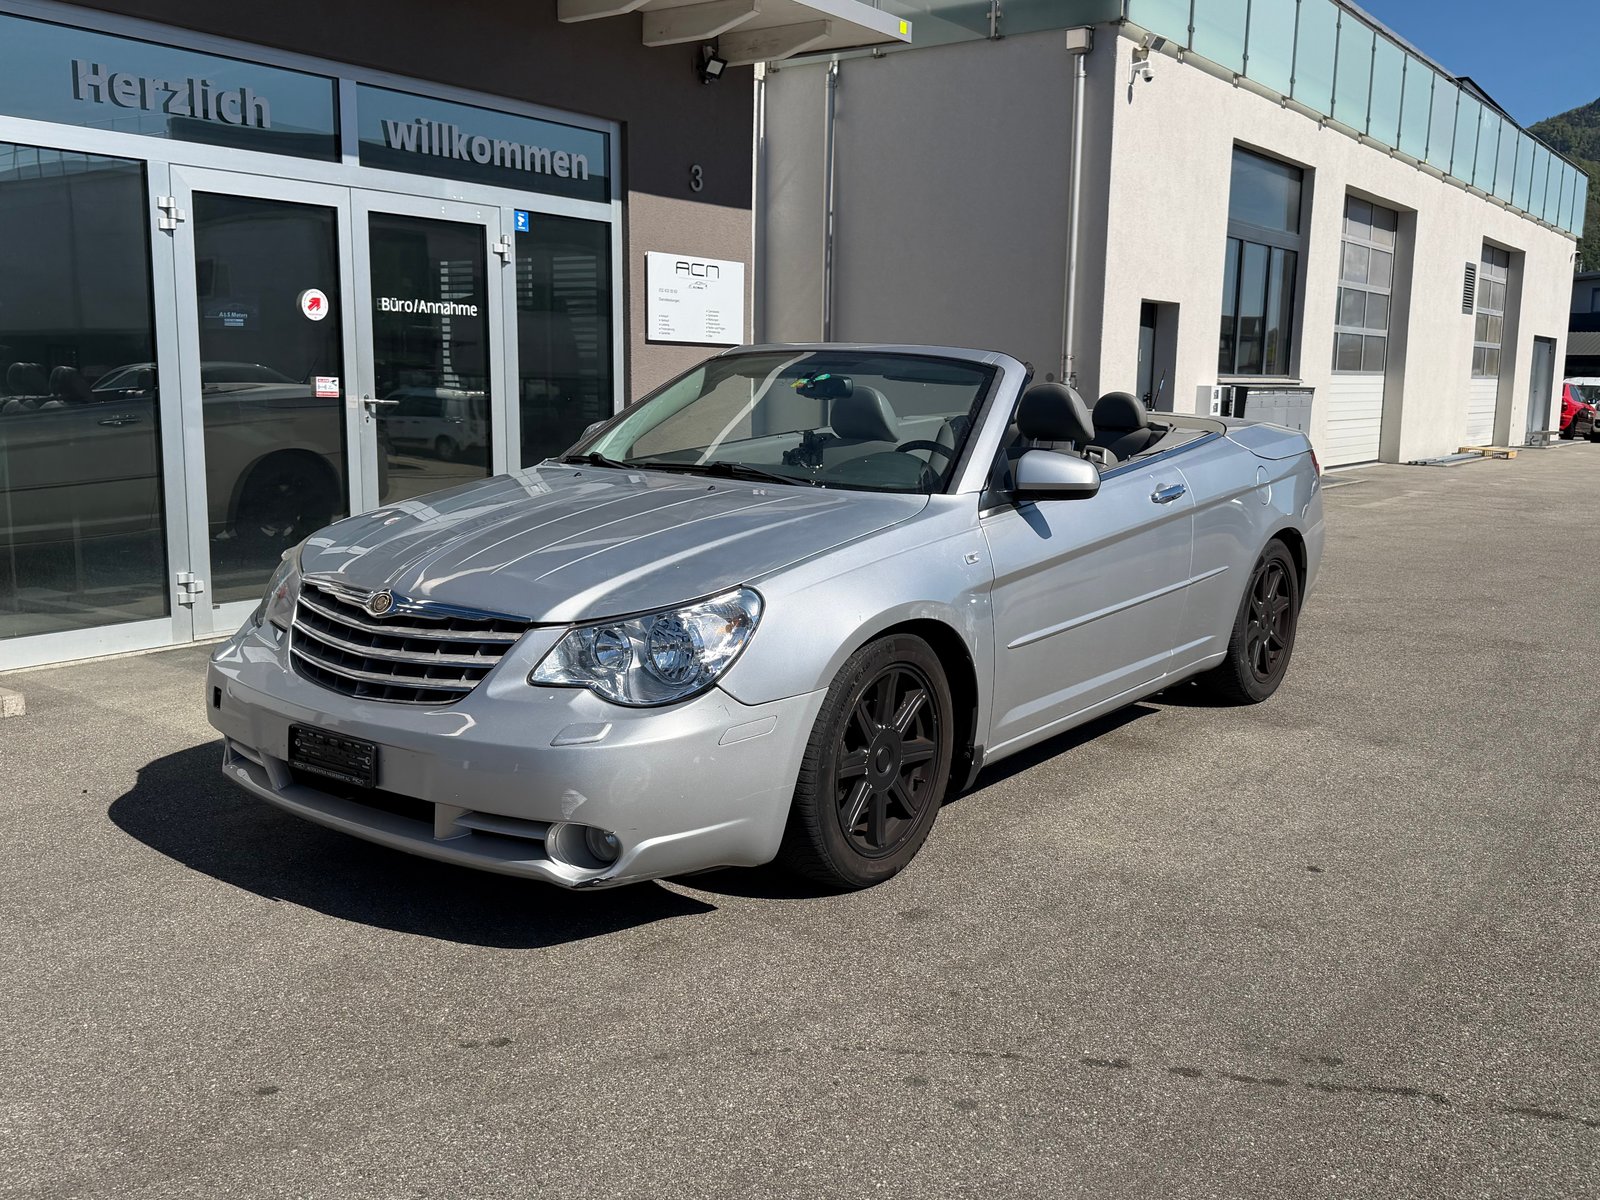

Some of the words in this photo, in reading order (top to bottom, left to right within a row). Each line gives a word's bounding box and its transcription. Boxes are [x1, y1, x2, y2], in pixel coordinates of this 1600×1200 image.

[74, 59, 271, 129] Herzlich
[385, 117, 589, 181] willkommen
[691, 164, 704, 192] 3
[381, 297, 478, 316] Büro/Annahme
